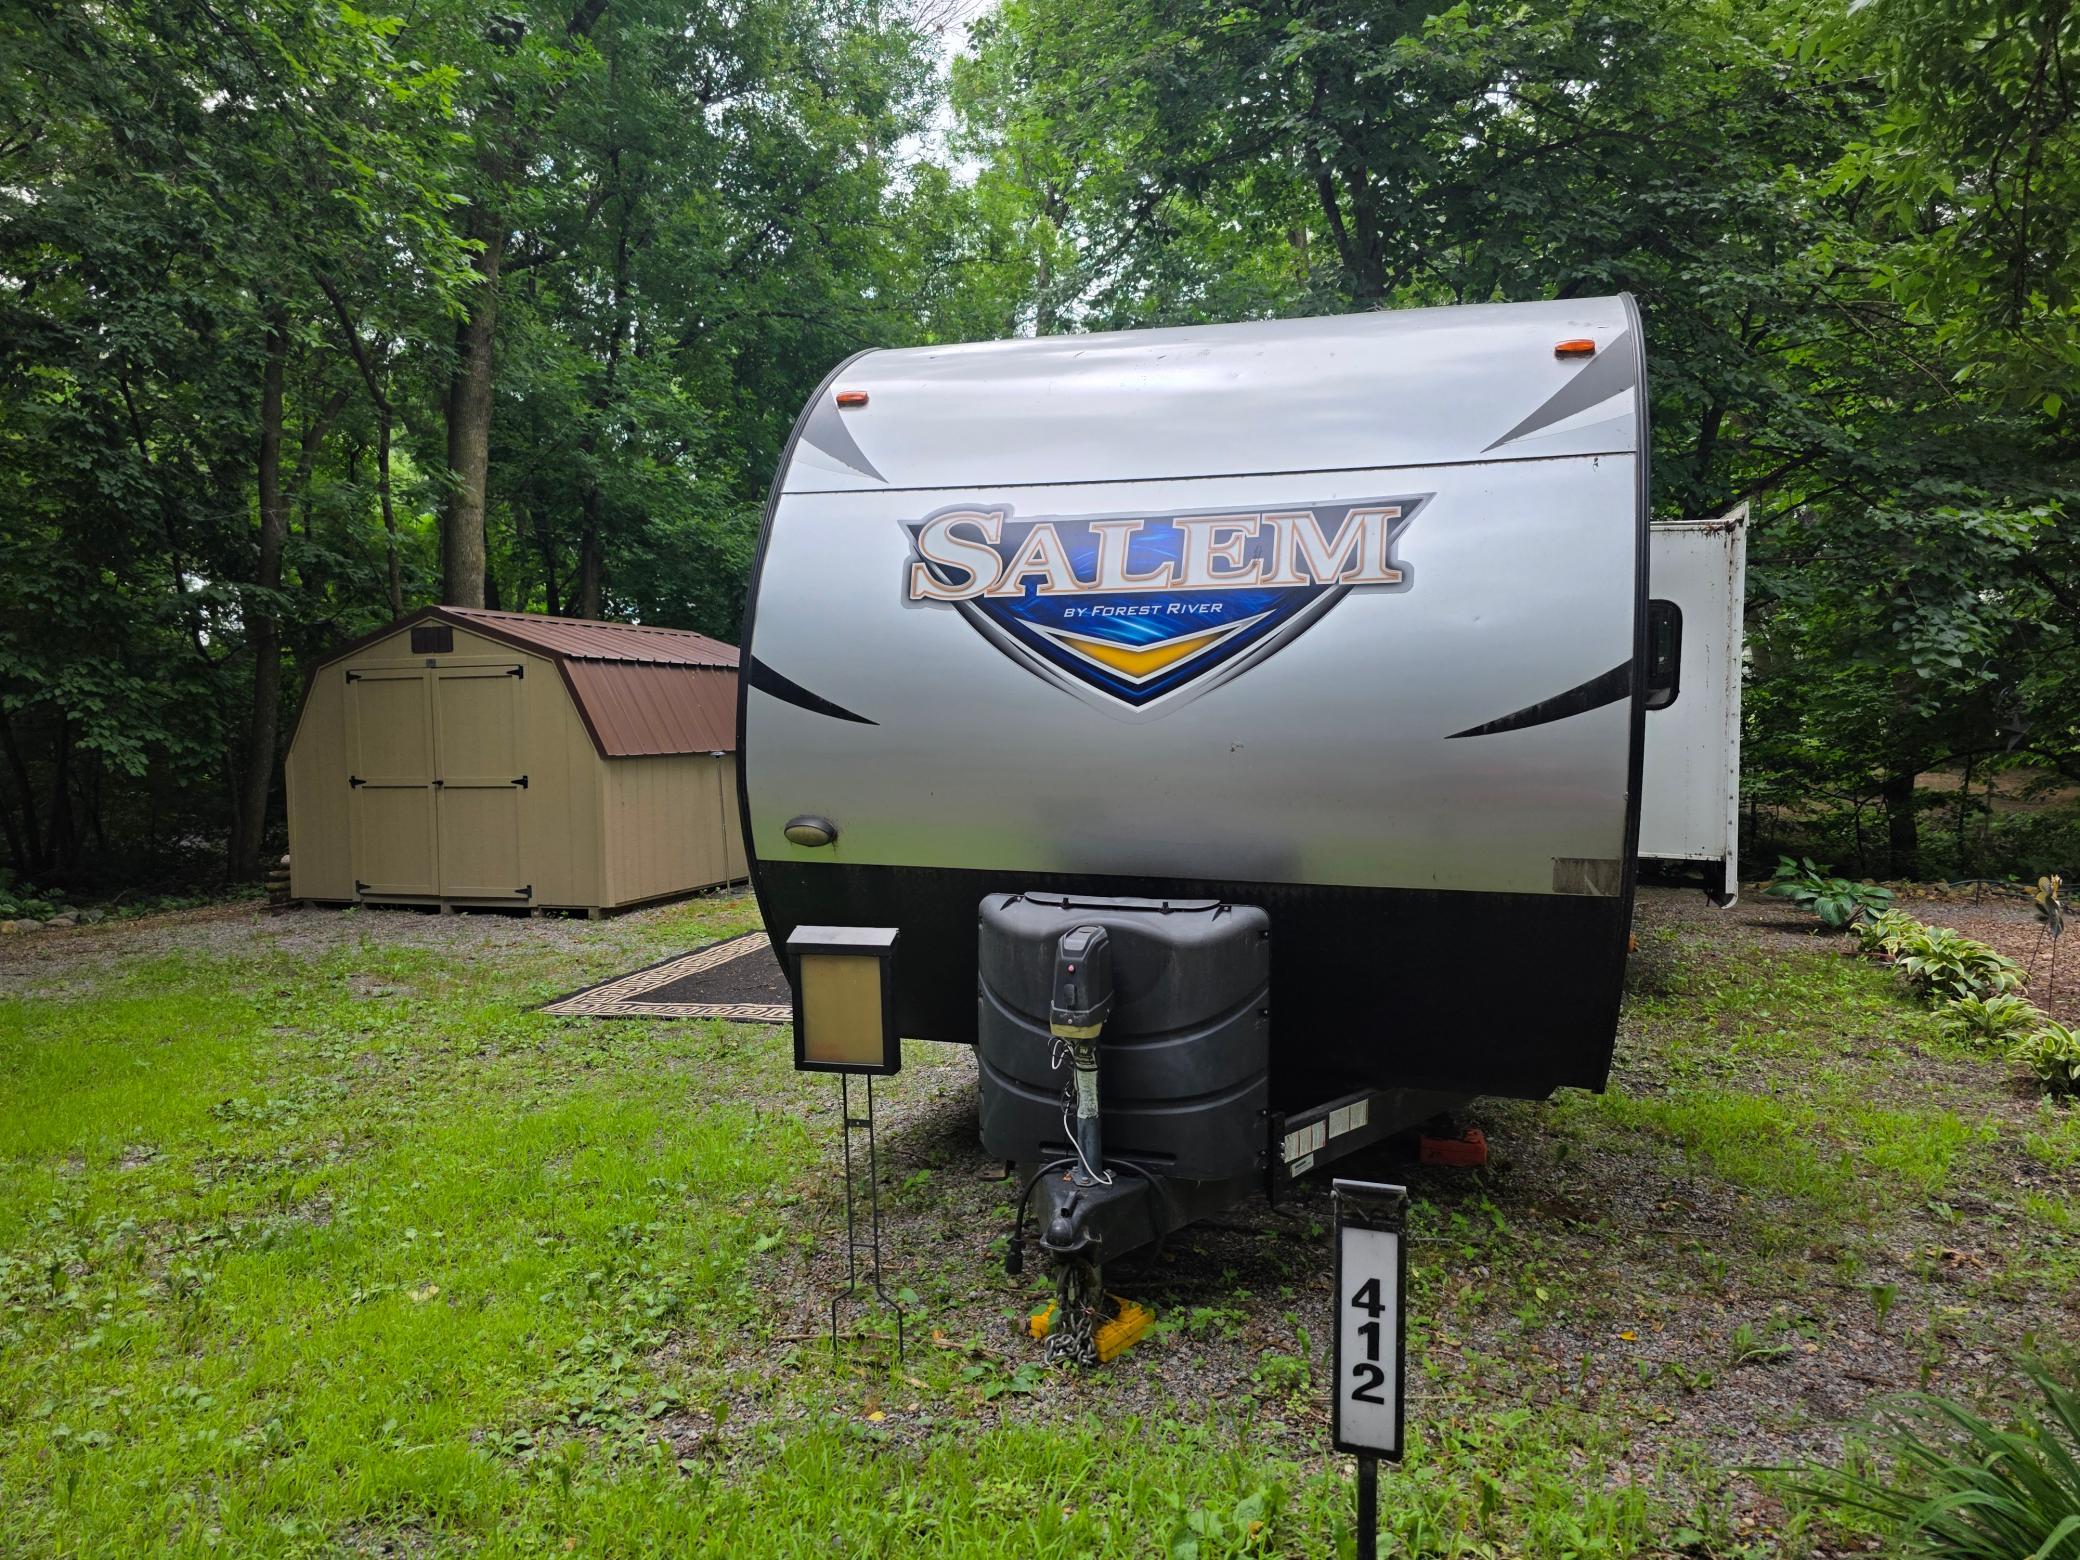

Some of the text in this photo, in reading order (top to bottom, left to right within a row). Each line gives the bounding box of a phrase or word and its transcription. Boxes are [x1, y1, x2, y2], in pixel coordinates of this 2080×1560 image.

[909, 507, 1402, 600] SALEM
[1064, 603, 1223, 618] BY FOREST RIVER
[1351, 1278, 1386, 1406] 412
